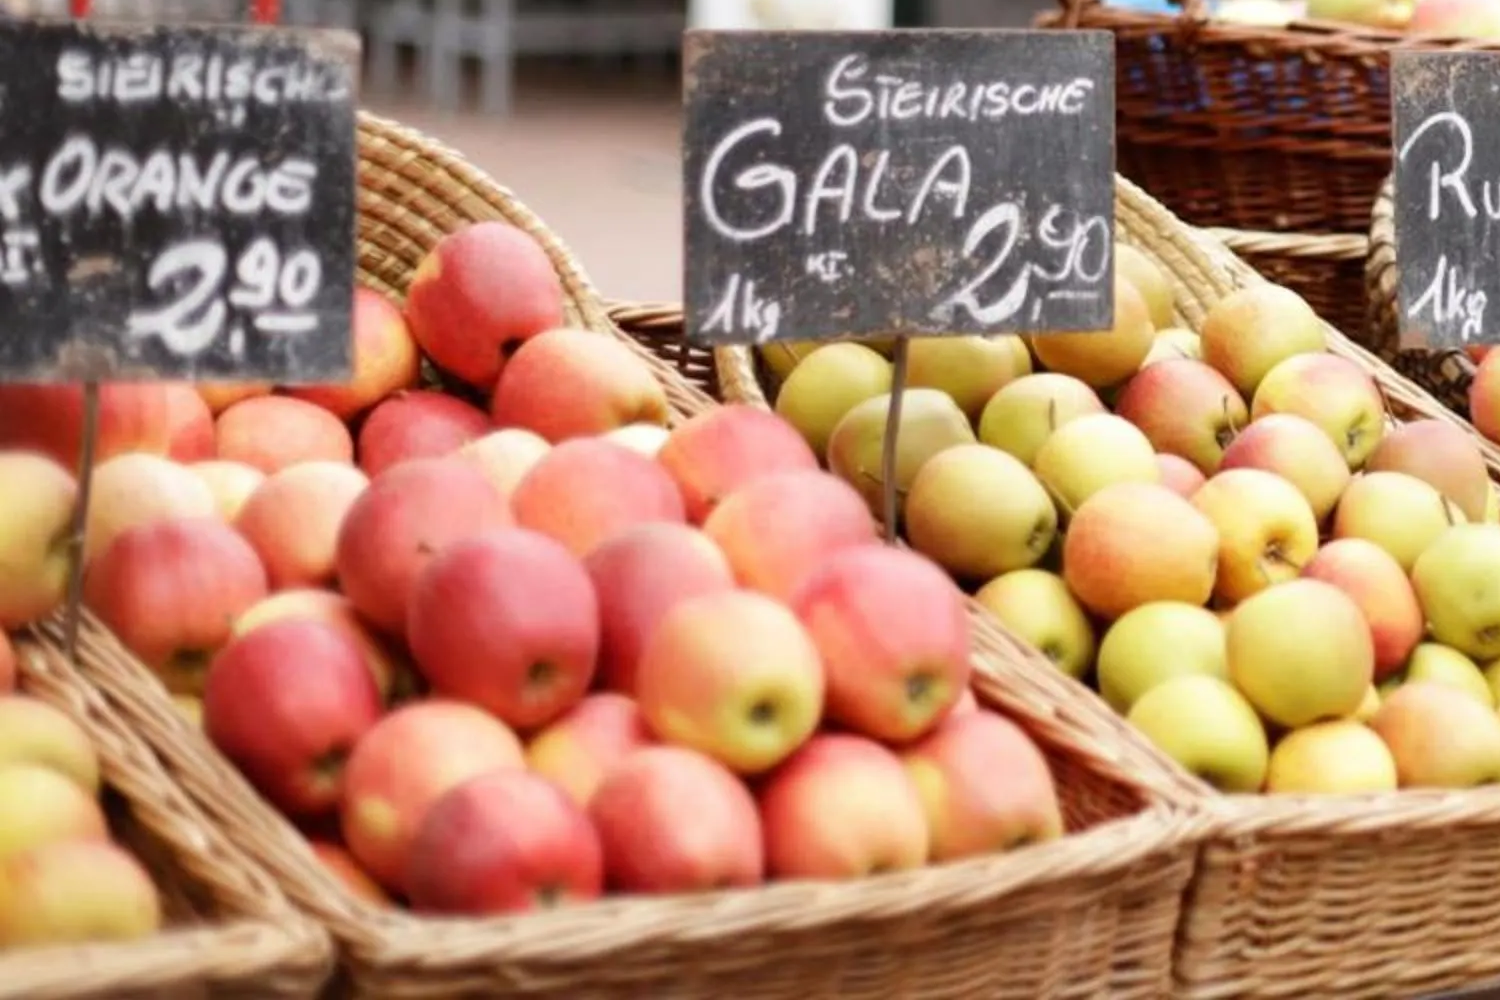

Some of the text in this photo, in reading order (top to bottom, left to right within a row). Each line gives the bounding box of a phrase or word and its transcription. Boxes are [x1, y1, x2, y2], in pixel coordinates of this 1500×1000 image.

[824, 53, 1093, 126] STEIRISCHE
[40, 134, 317, 220] ORANGE
[702, 117, 972, 240] GALA
